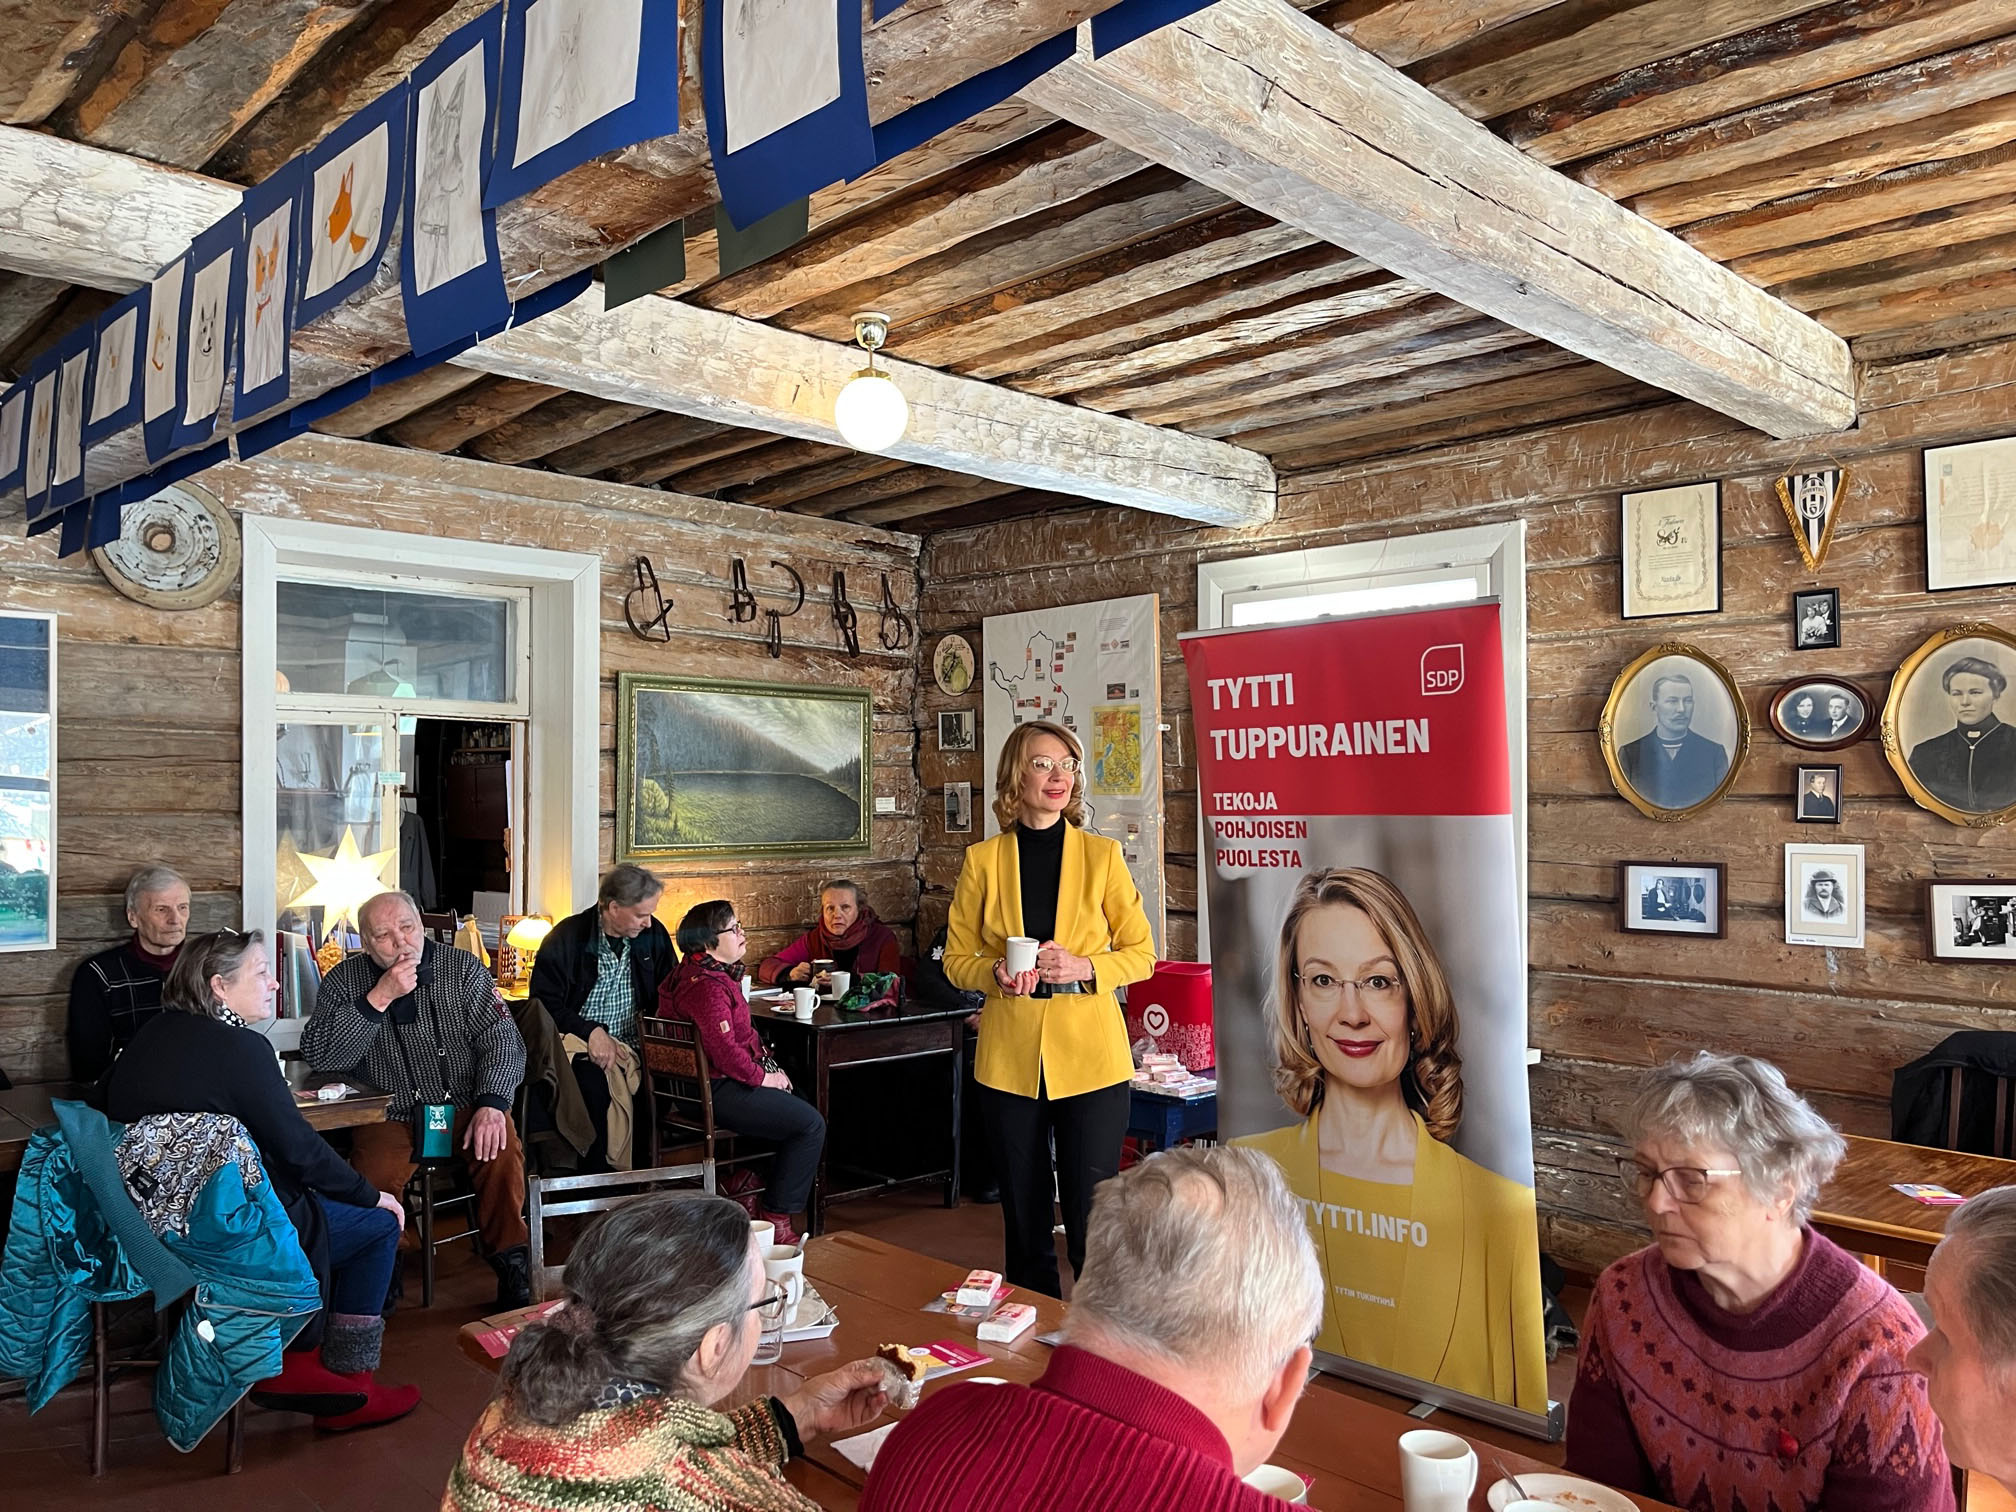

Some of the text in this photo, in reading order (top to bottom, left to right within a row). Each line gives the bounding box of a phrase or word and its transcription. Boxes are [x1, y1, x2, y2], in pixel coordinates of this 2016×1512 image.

[1426, 669, 1459, 688] SDP
[1207, 673, 1294, 710] TYTTI
[1210, 718, 1430, 761] TUPPURAINEN
[1213, 792, 1278, 811] TEKOJA
[1215, 821, 1308, 839] POHJOISEN
[1216, 849, 1302, 868] PUOLESTA
[1298, 1199, 1428, 1248] TYTTI.INFO
